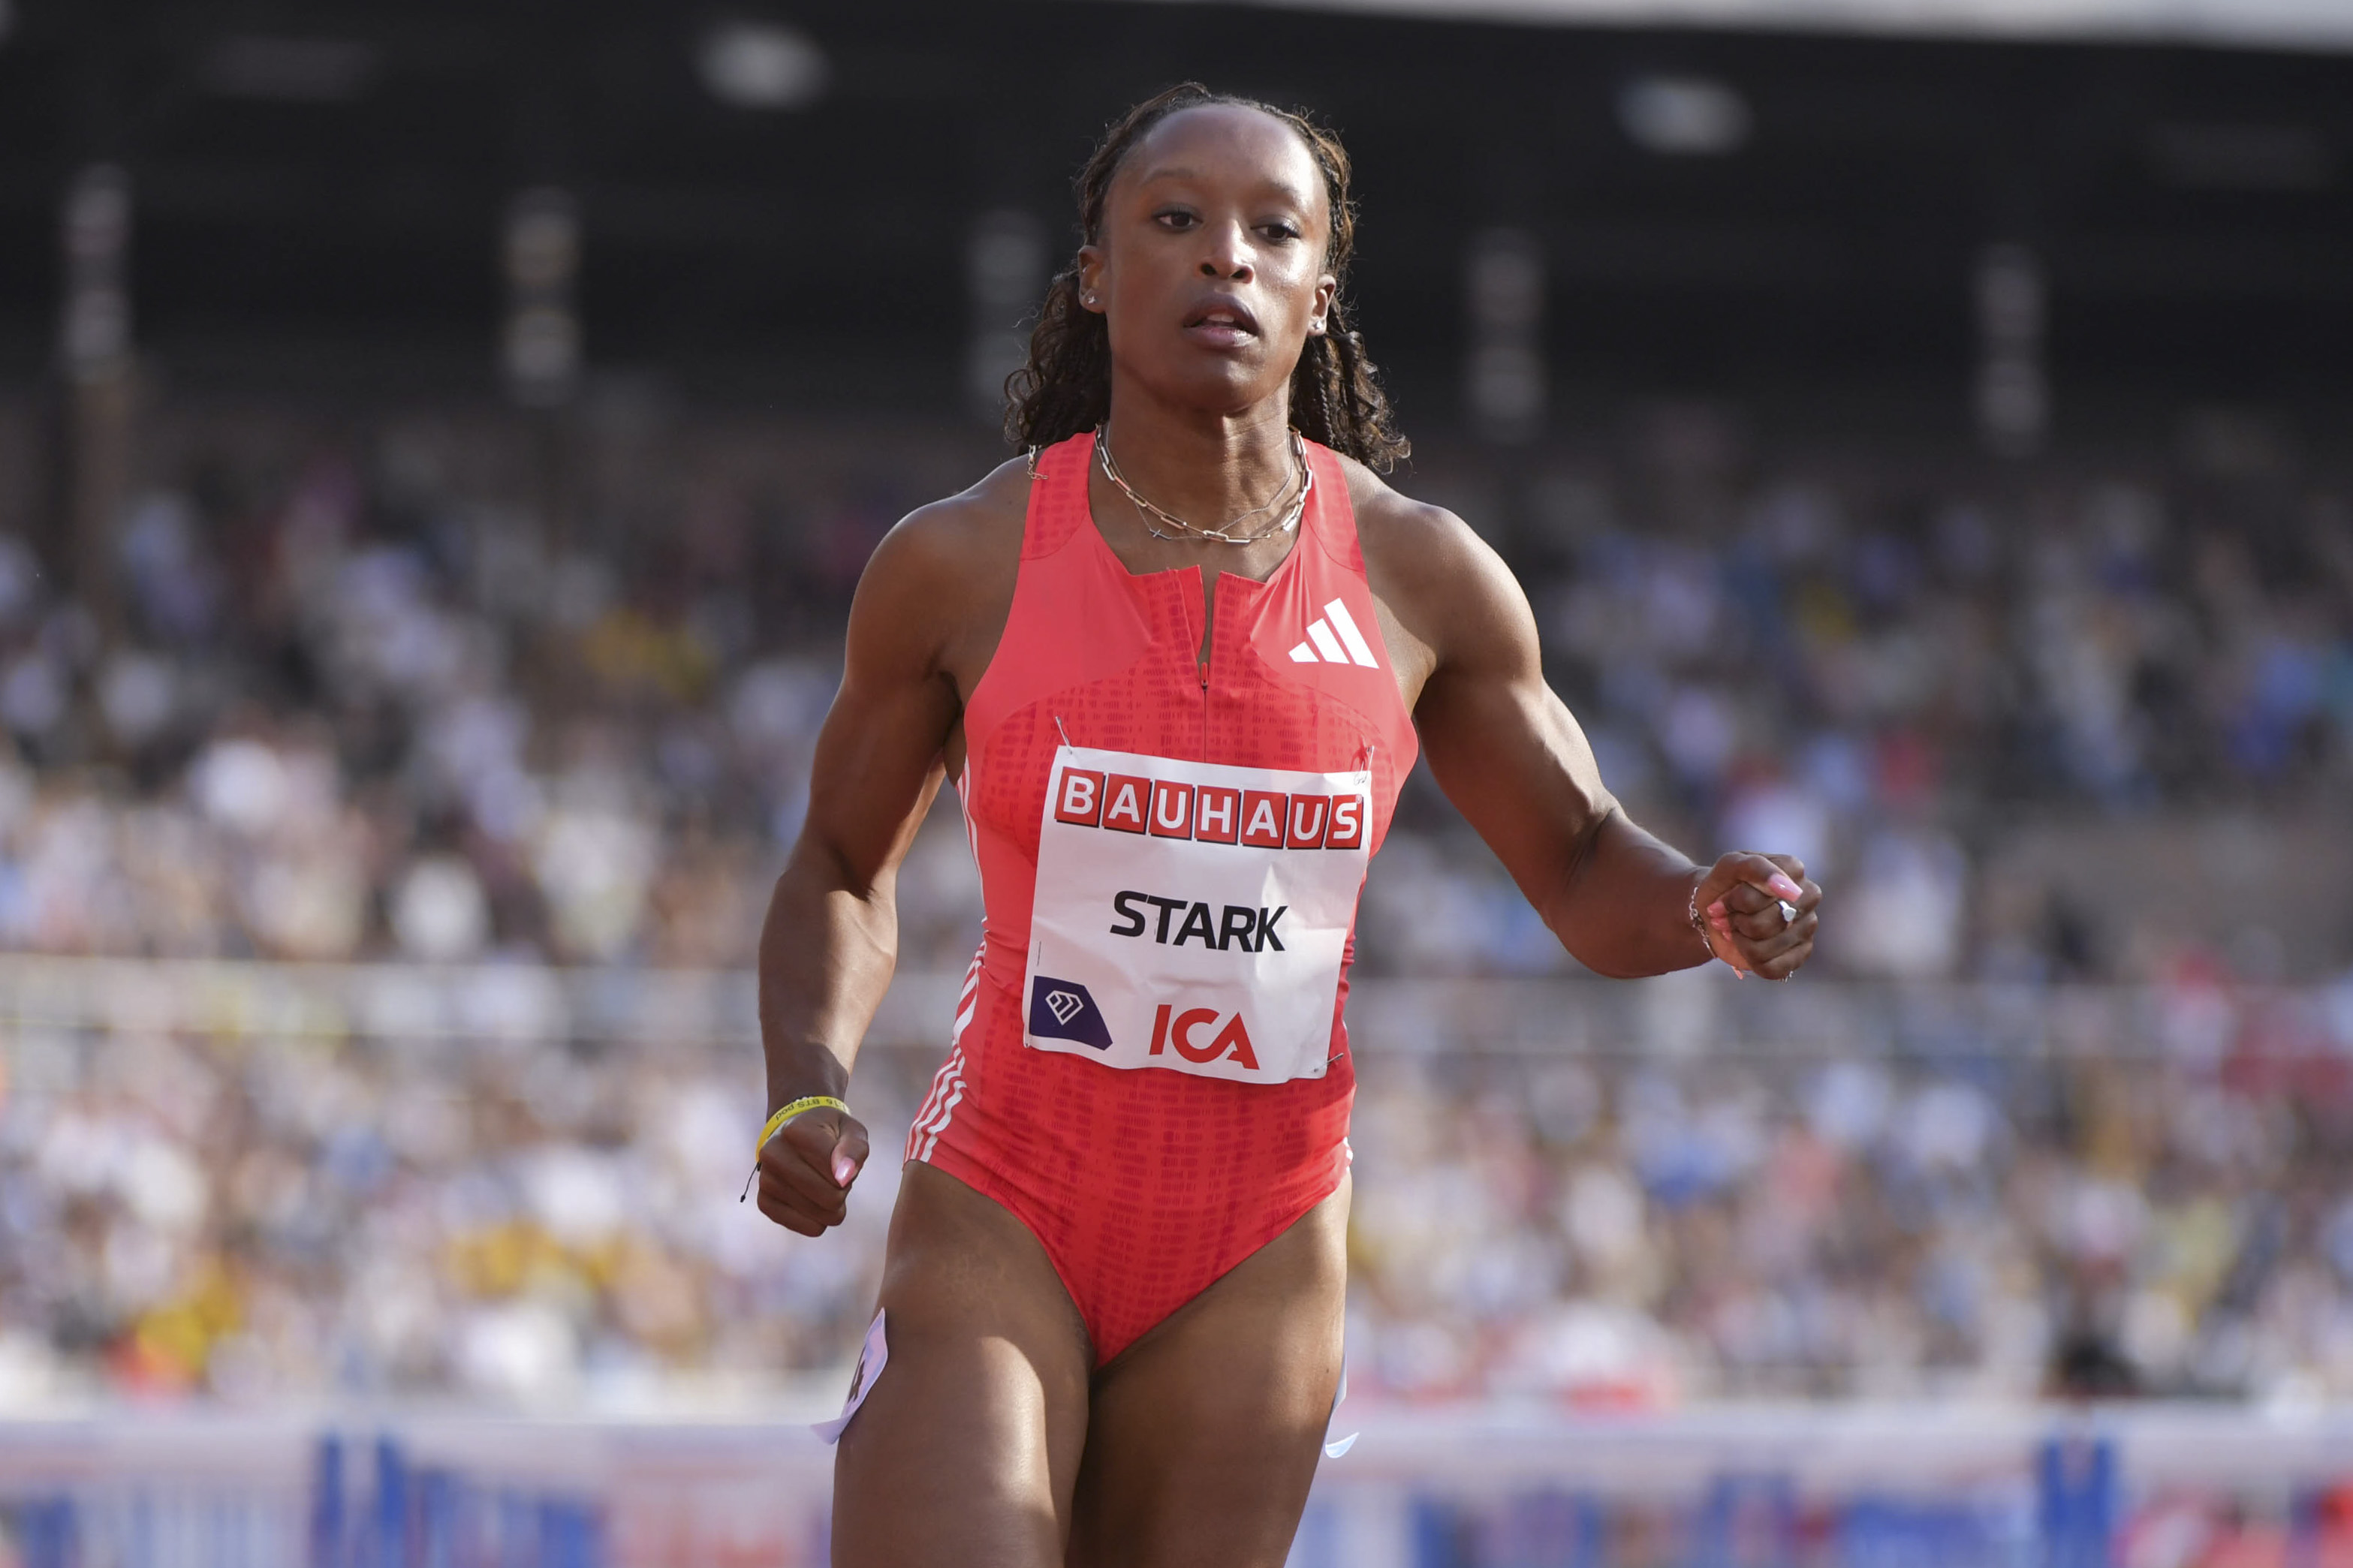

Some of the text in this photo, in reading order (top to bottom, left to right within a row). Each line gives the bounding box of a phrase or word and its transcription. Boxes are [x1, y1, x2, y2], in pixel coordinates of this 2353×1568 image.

[1062, 775, 1359, 840] BAUHAUS
[1109, 890, 1288, 953] STARK
[1149, 1004, 1260, 1070] ICA
[776, 1104, 795, 1121] pod
[797, 1098, 821, 1108] BTS
